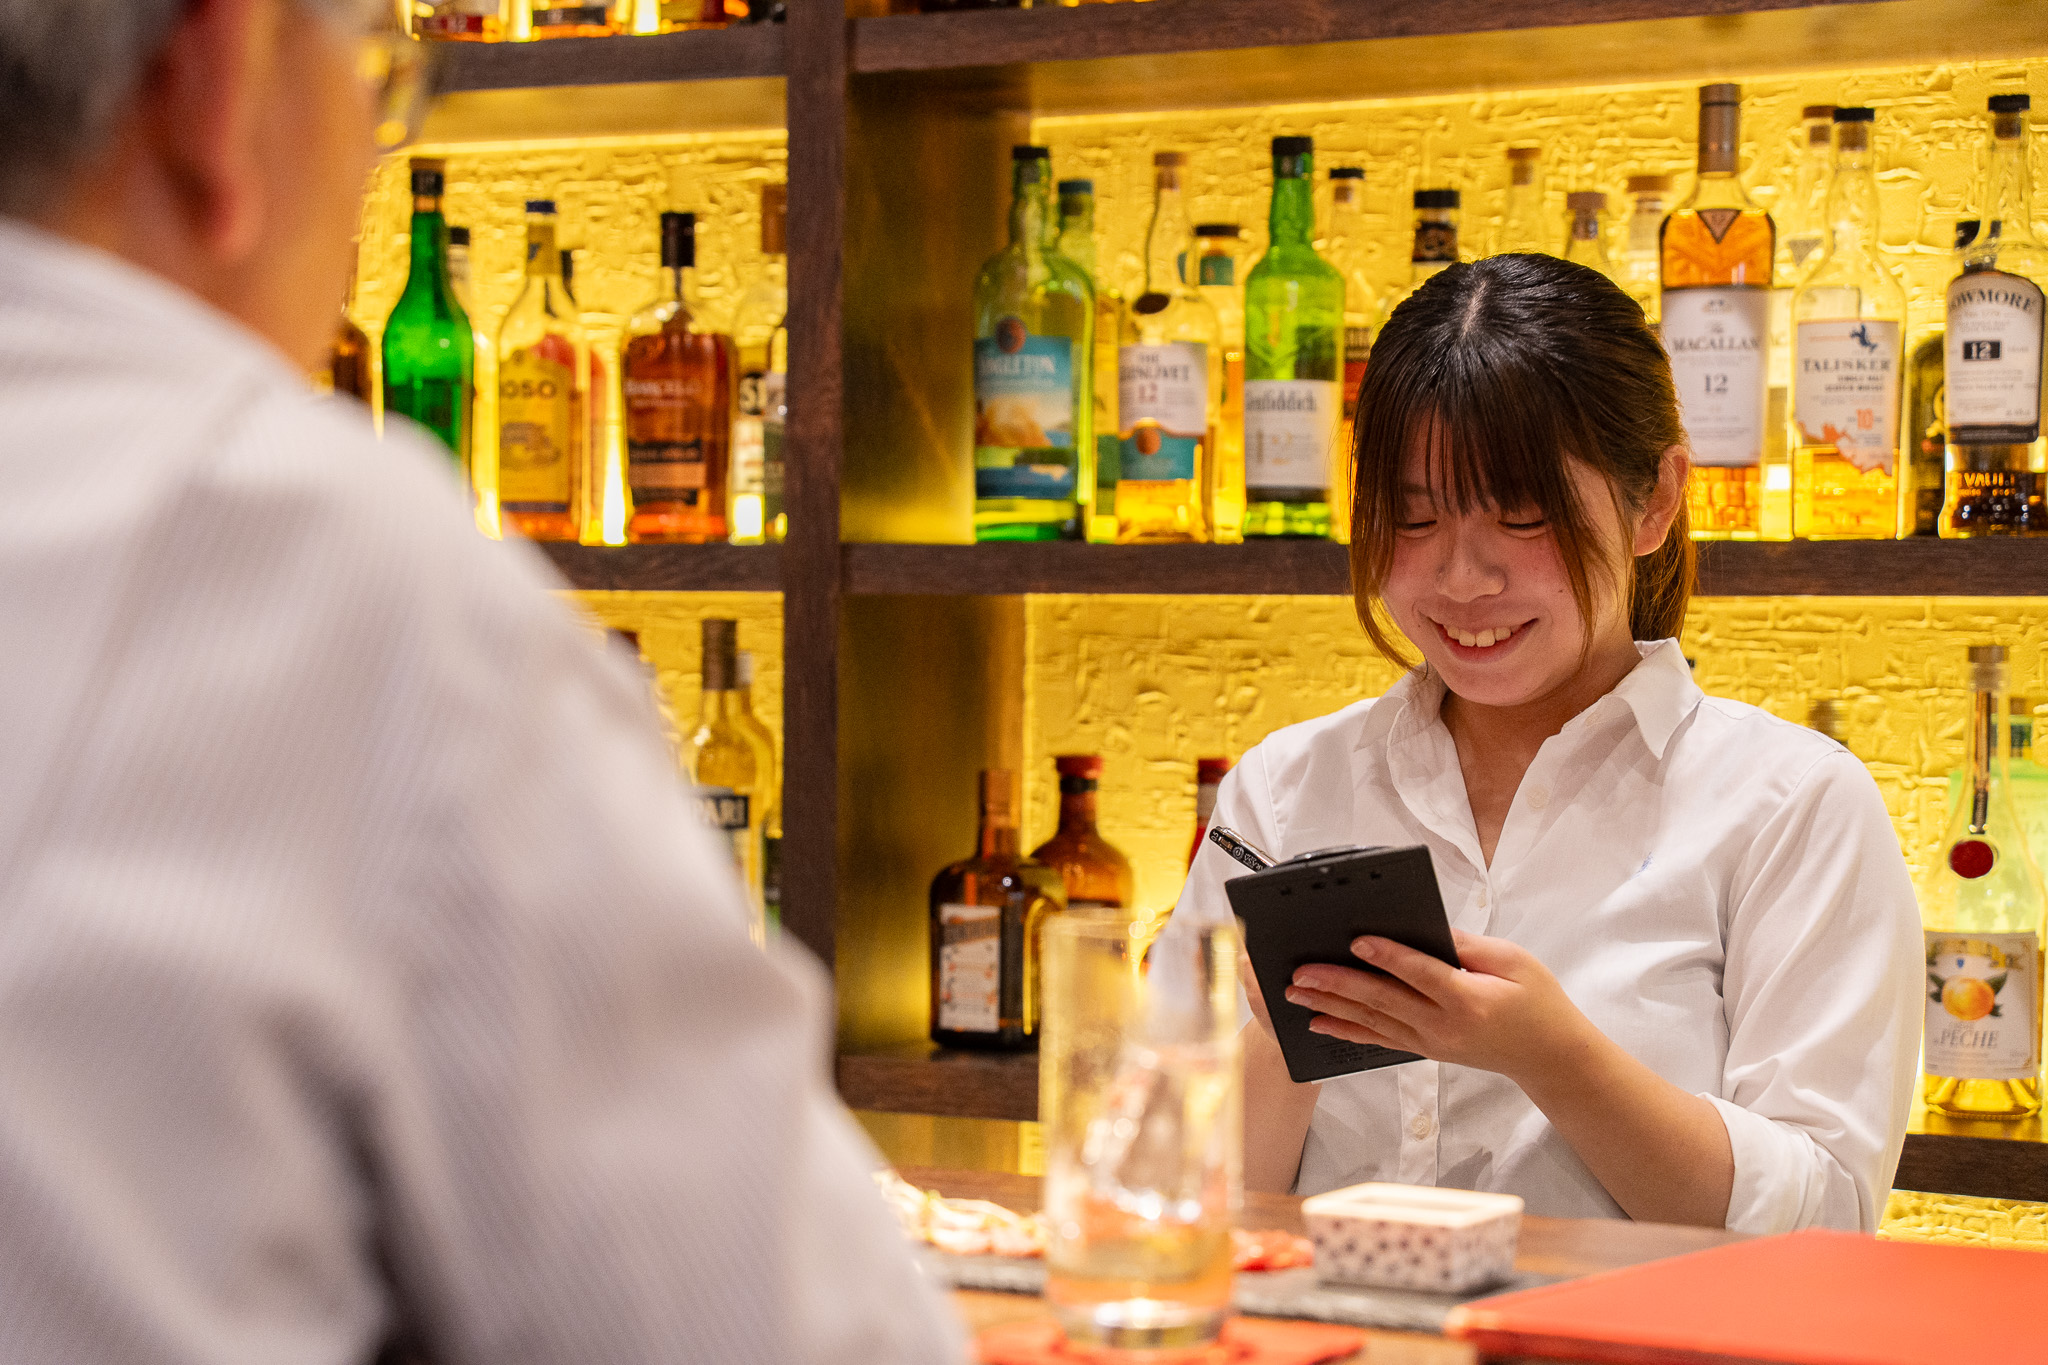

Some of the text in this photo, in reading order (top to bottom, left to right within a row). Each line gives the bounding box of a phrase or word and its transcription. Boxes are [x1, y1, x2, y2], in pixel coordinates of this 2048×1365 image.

[1948, 289, 2034, 315] OWMORE
[1673, 336, 1760, 351] MACALLAN
[1970, 342, 1992, 359] 12
[1803, 358, 1891, 372] TALISKER
[1705, 374, 1729, 393] 12
